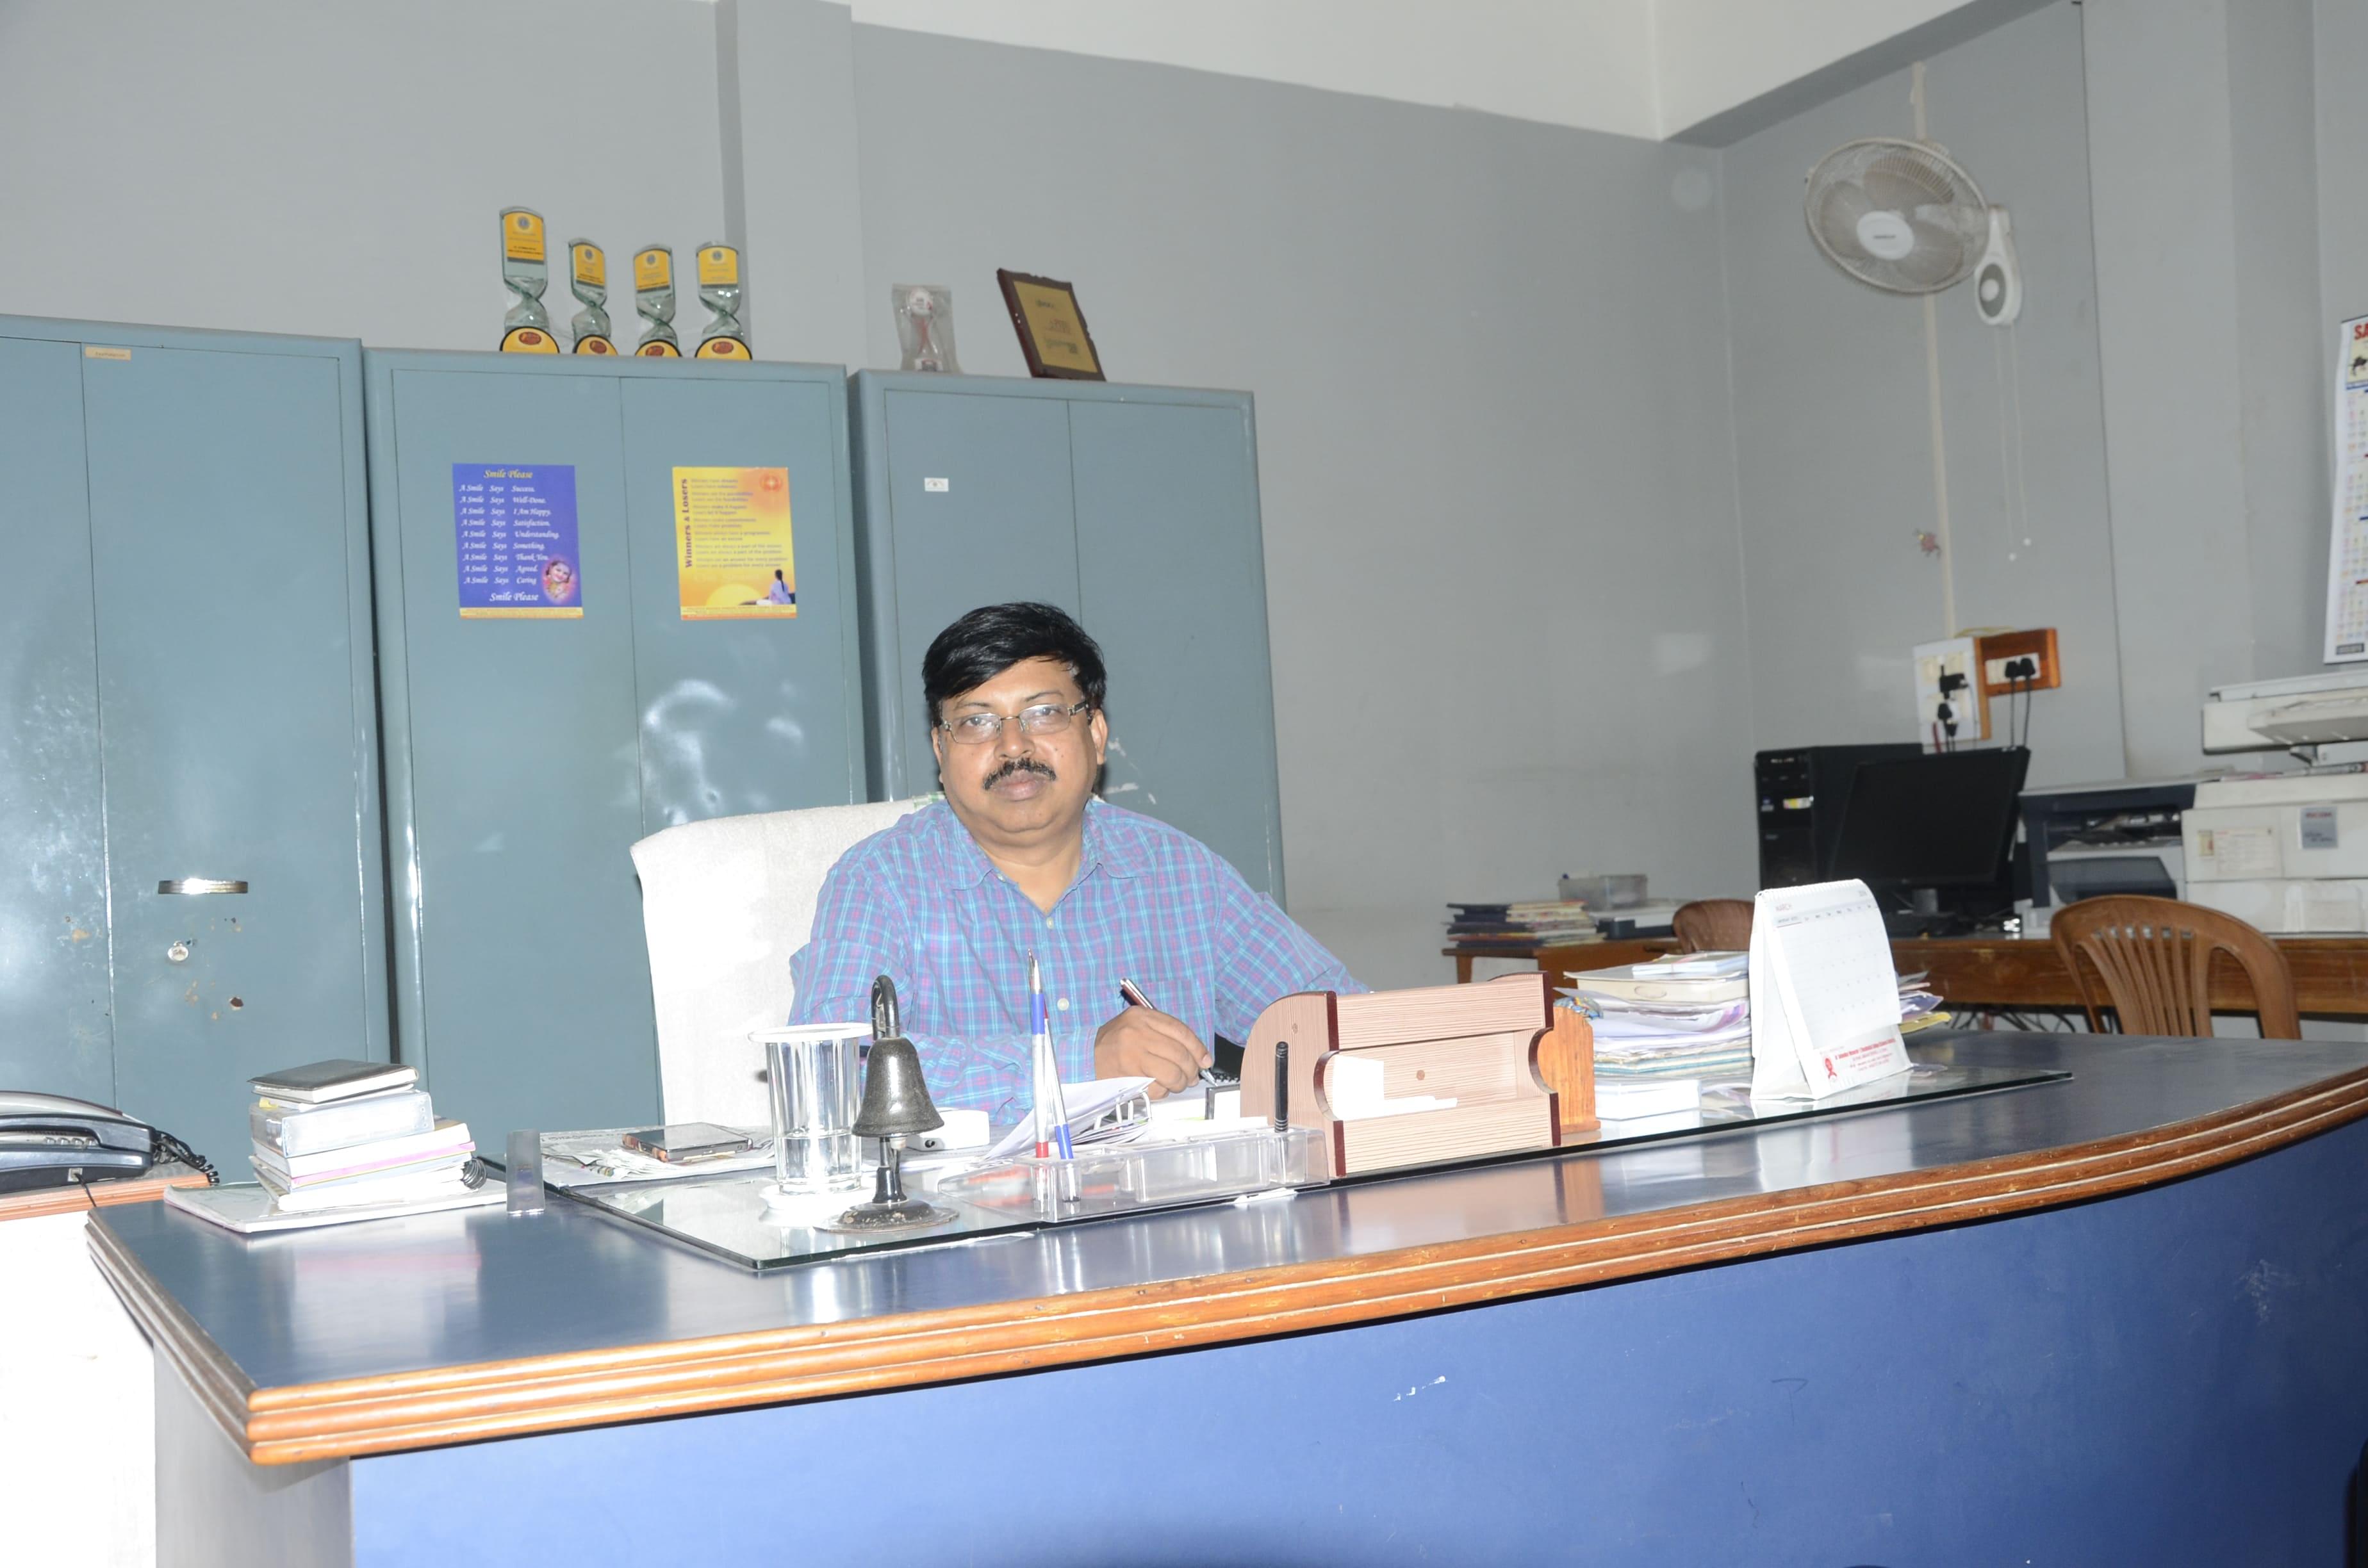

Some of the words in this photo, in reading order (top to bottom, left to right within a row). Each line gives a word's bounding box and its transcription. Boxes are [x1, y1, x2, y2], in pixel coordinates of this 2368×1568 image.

[484, 469, 506, 478] Smile
[507, 470, 533, 478] Please
[491, 519, 506, 528] Says
[493, 543, 507, 551] Says
[516, 553, 536, 562] Thank
[489, 591, 513, 601] Smile
[513, 592, 538, 601] Please
